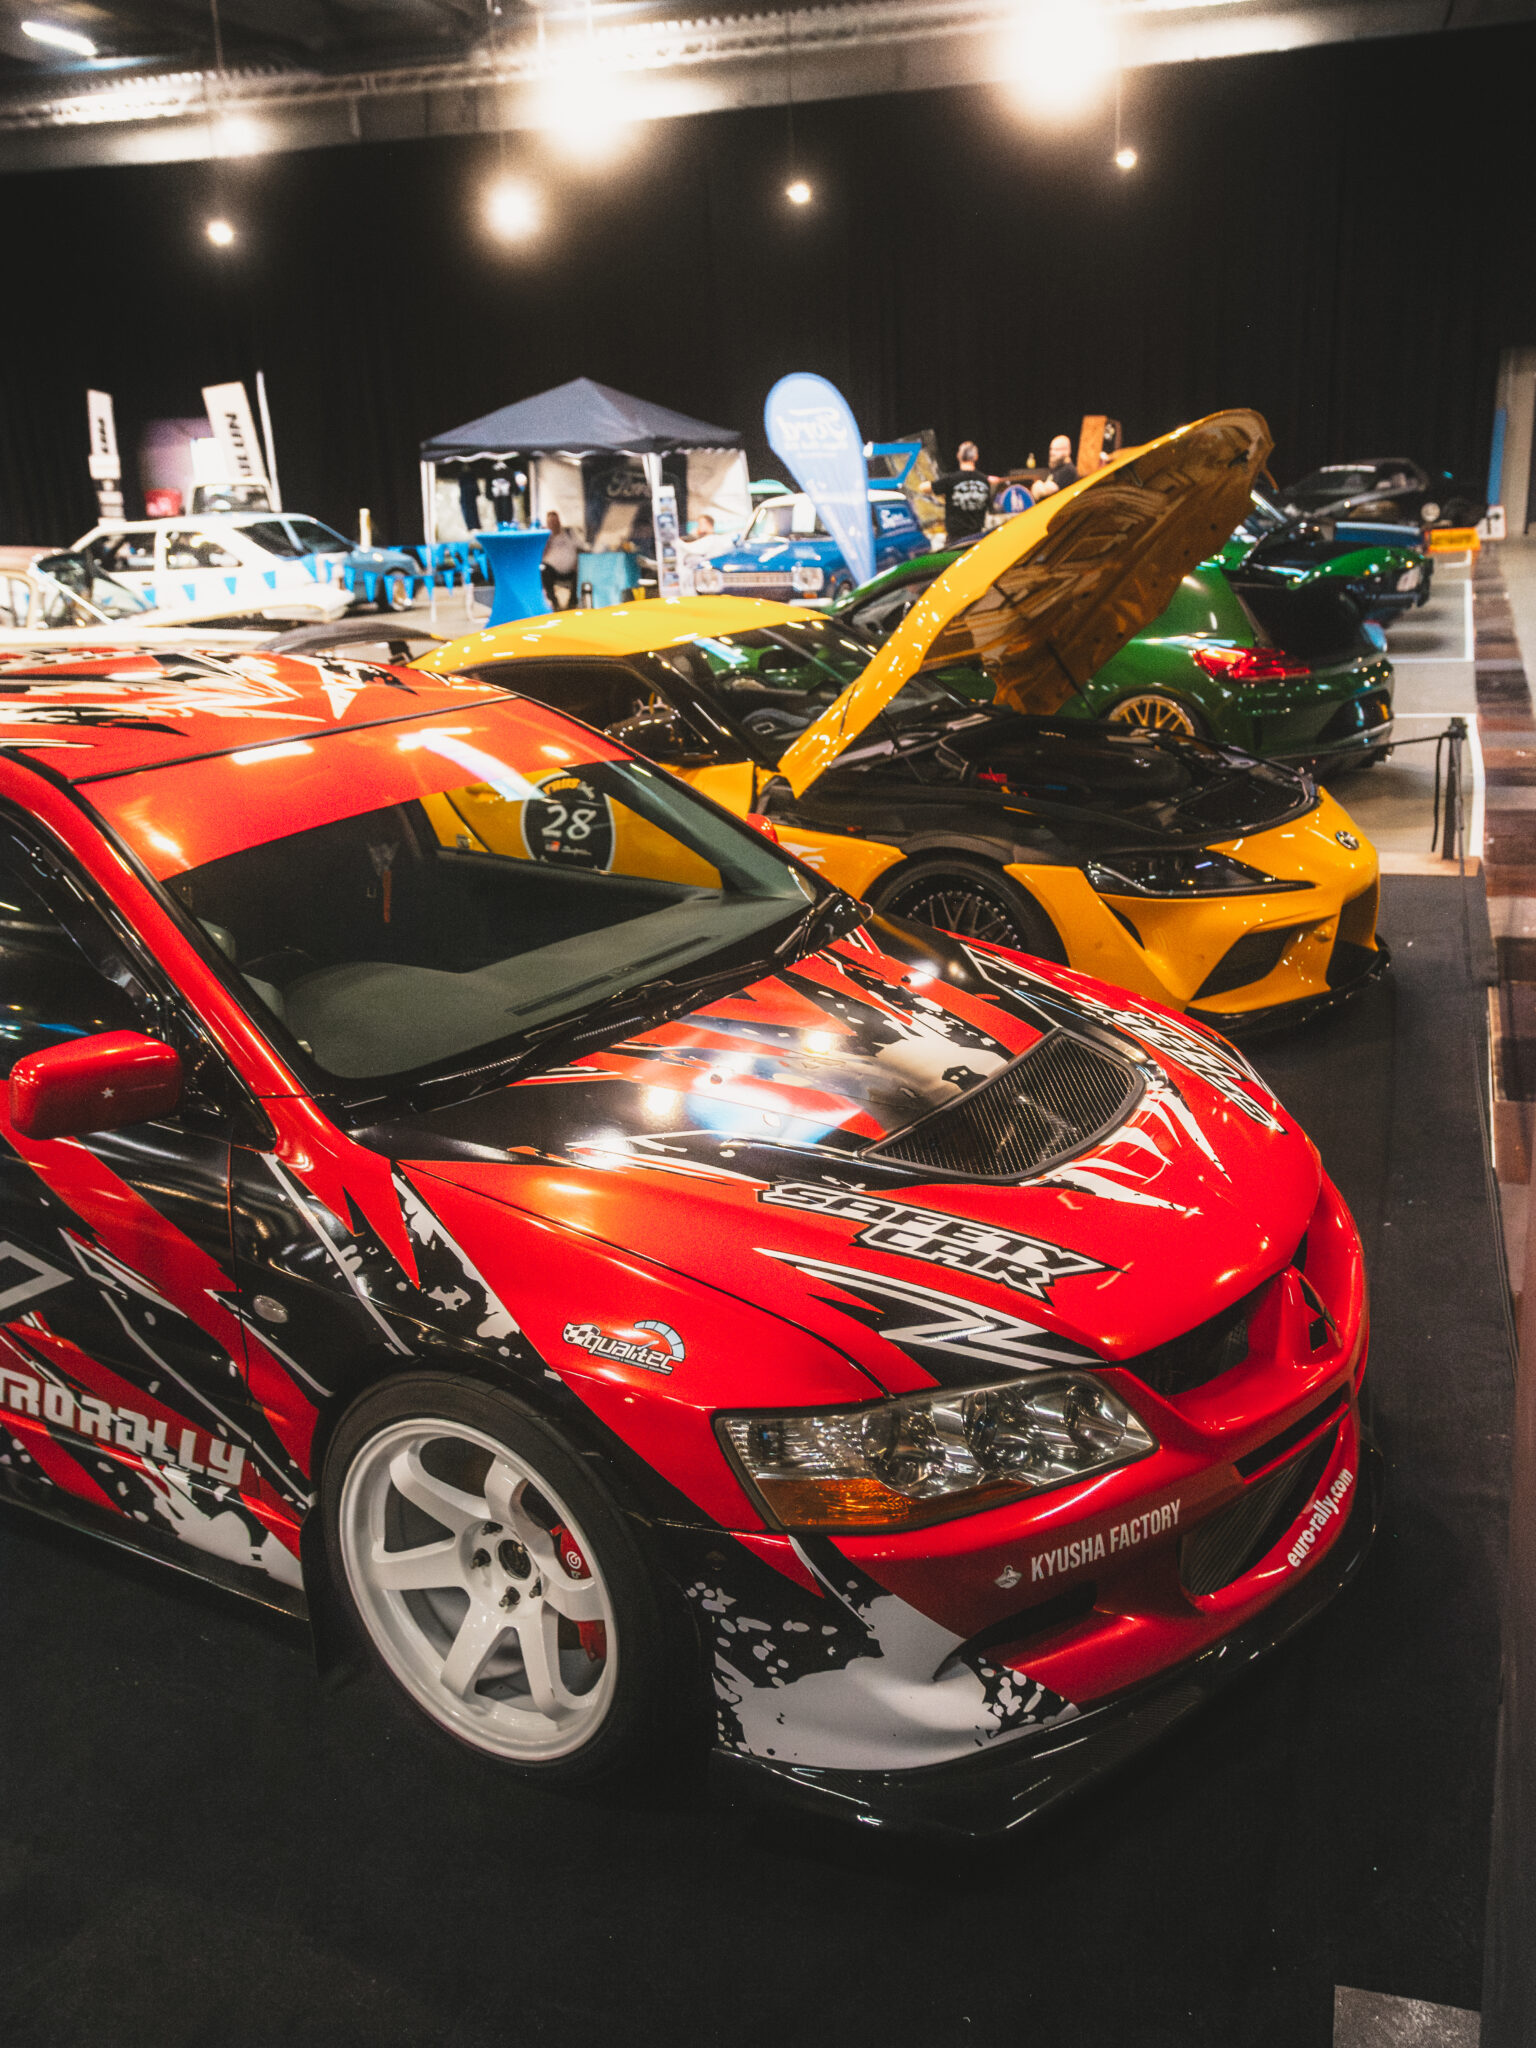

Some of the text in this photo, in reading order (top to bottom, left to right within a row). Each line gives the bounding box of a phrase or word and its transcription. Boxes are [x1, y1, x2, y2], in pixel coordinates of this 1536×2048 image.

[541, 804, 597, 840] 28
[763, 1184, 1106, 1273] SAFETY
[861, 1226, 1045, 1299] CAR
[1031, 1498, 1181, 1582] KYUSHA FACTORY
[1287, 1468, 1354, 1567] euro-rally.com
